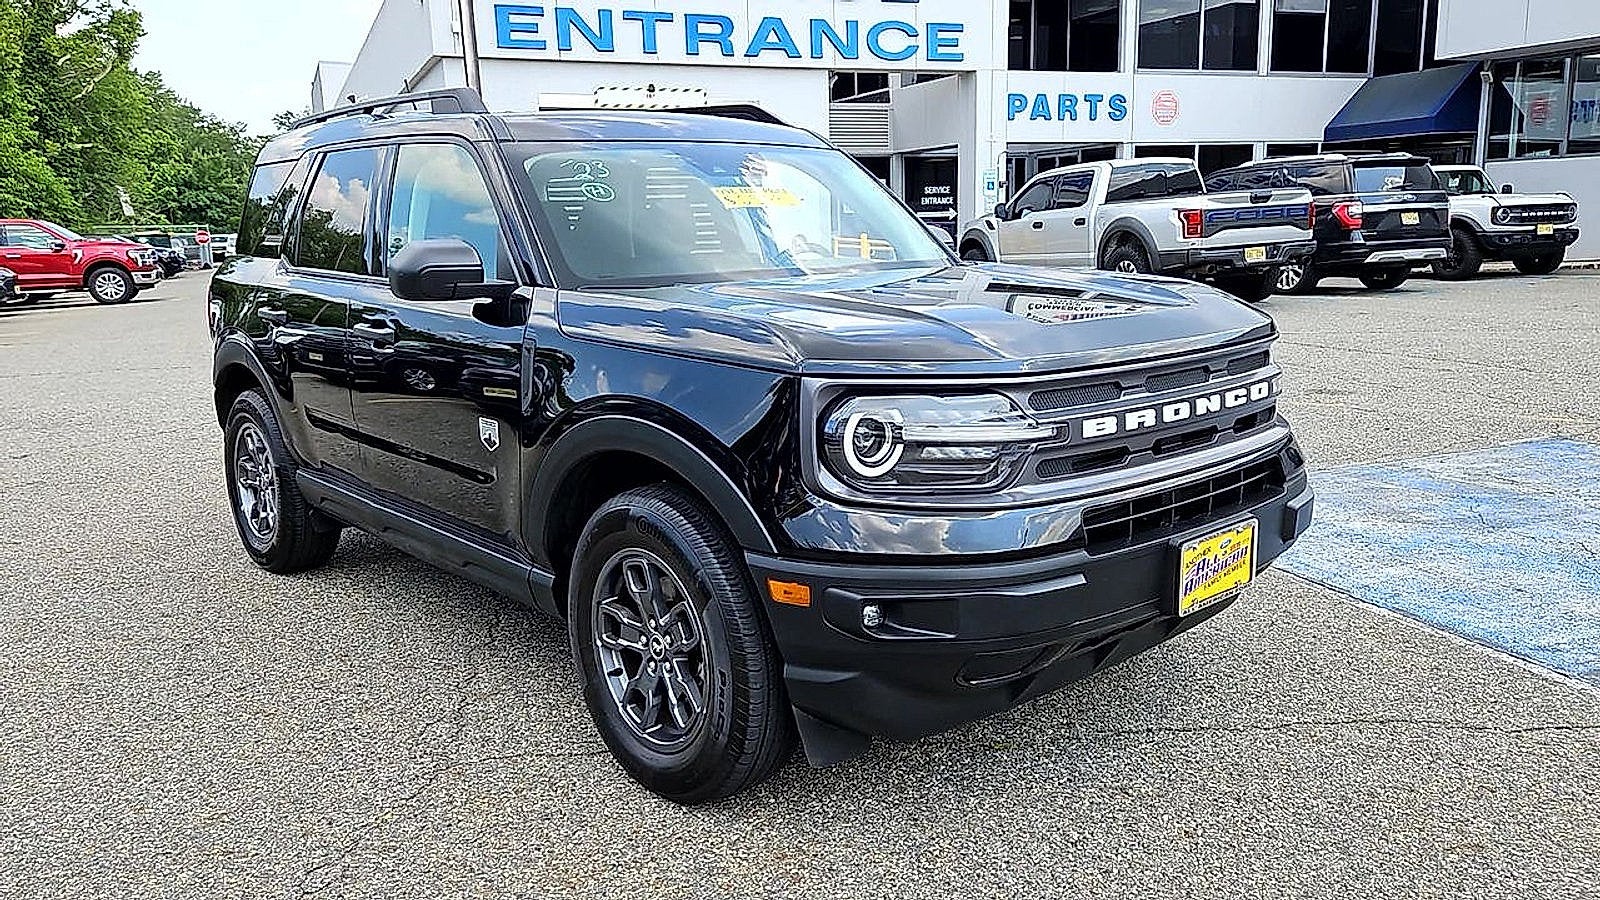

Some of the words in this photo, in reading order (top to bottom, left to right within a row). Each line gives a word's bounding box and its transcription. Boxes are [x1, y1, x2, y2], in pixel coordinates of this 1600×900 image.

[494, 4, 965, 61] ENTRANCE
[1007, 93, 1128, 122] PARTS
[921, 196, 954, 205] ENTRANCE
[924, 186, 951, 194] SERVICE
[1081, 381, 1270, 439] BRONCO
